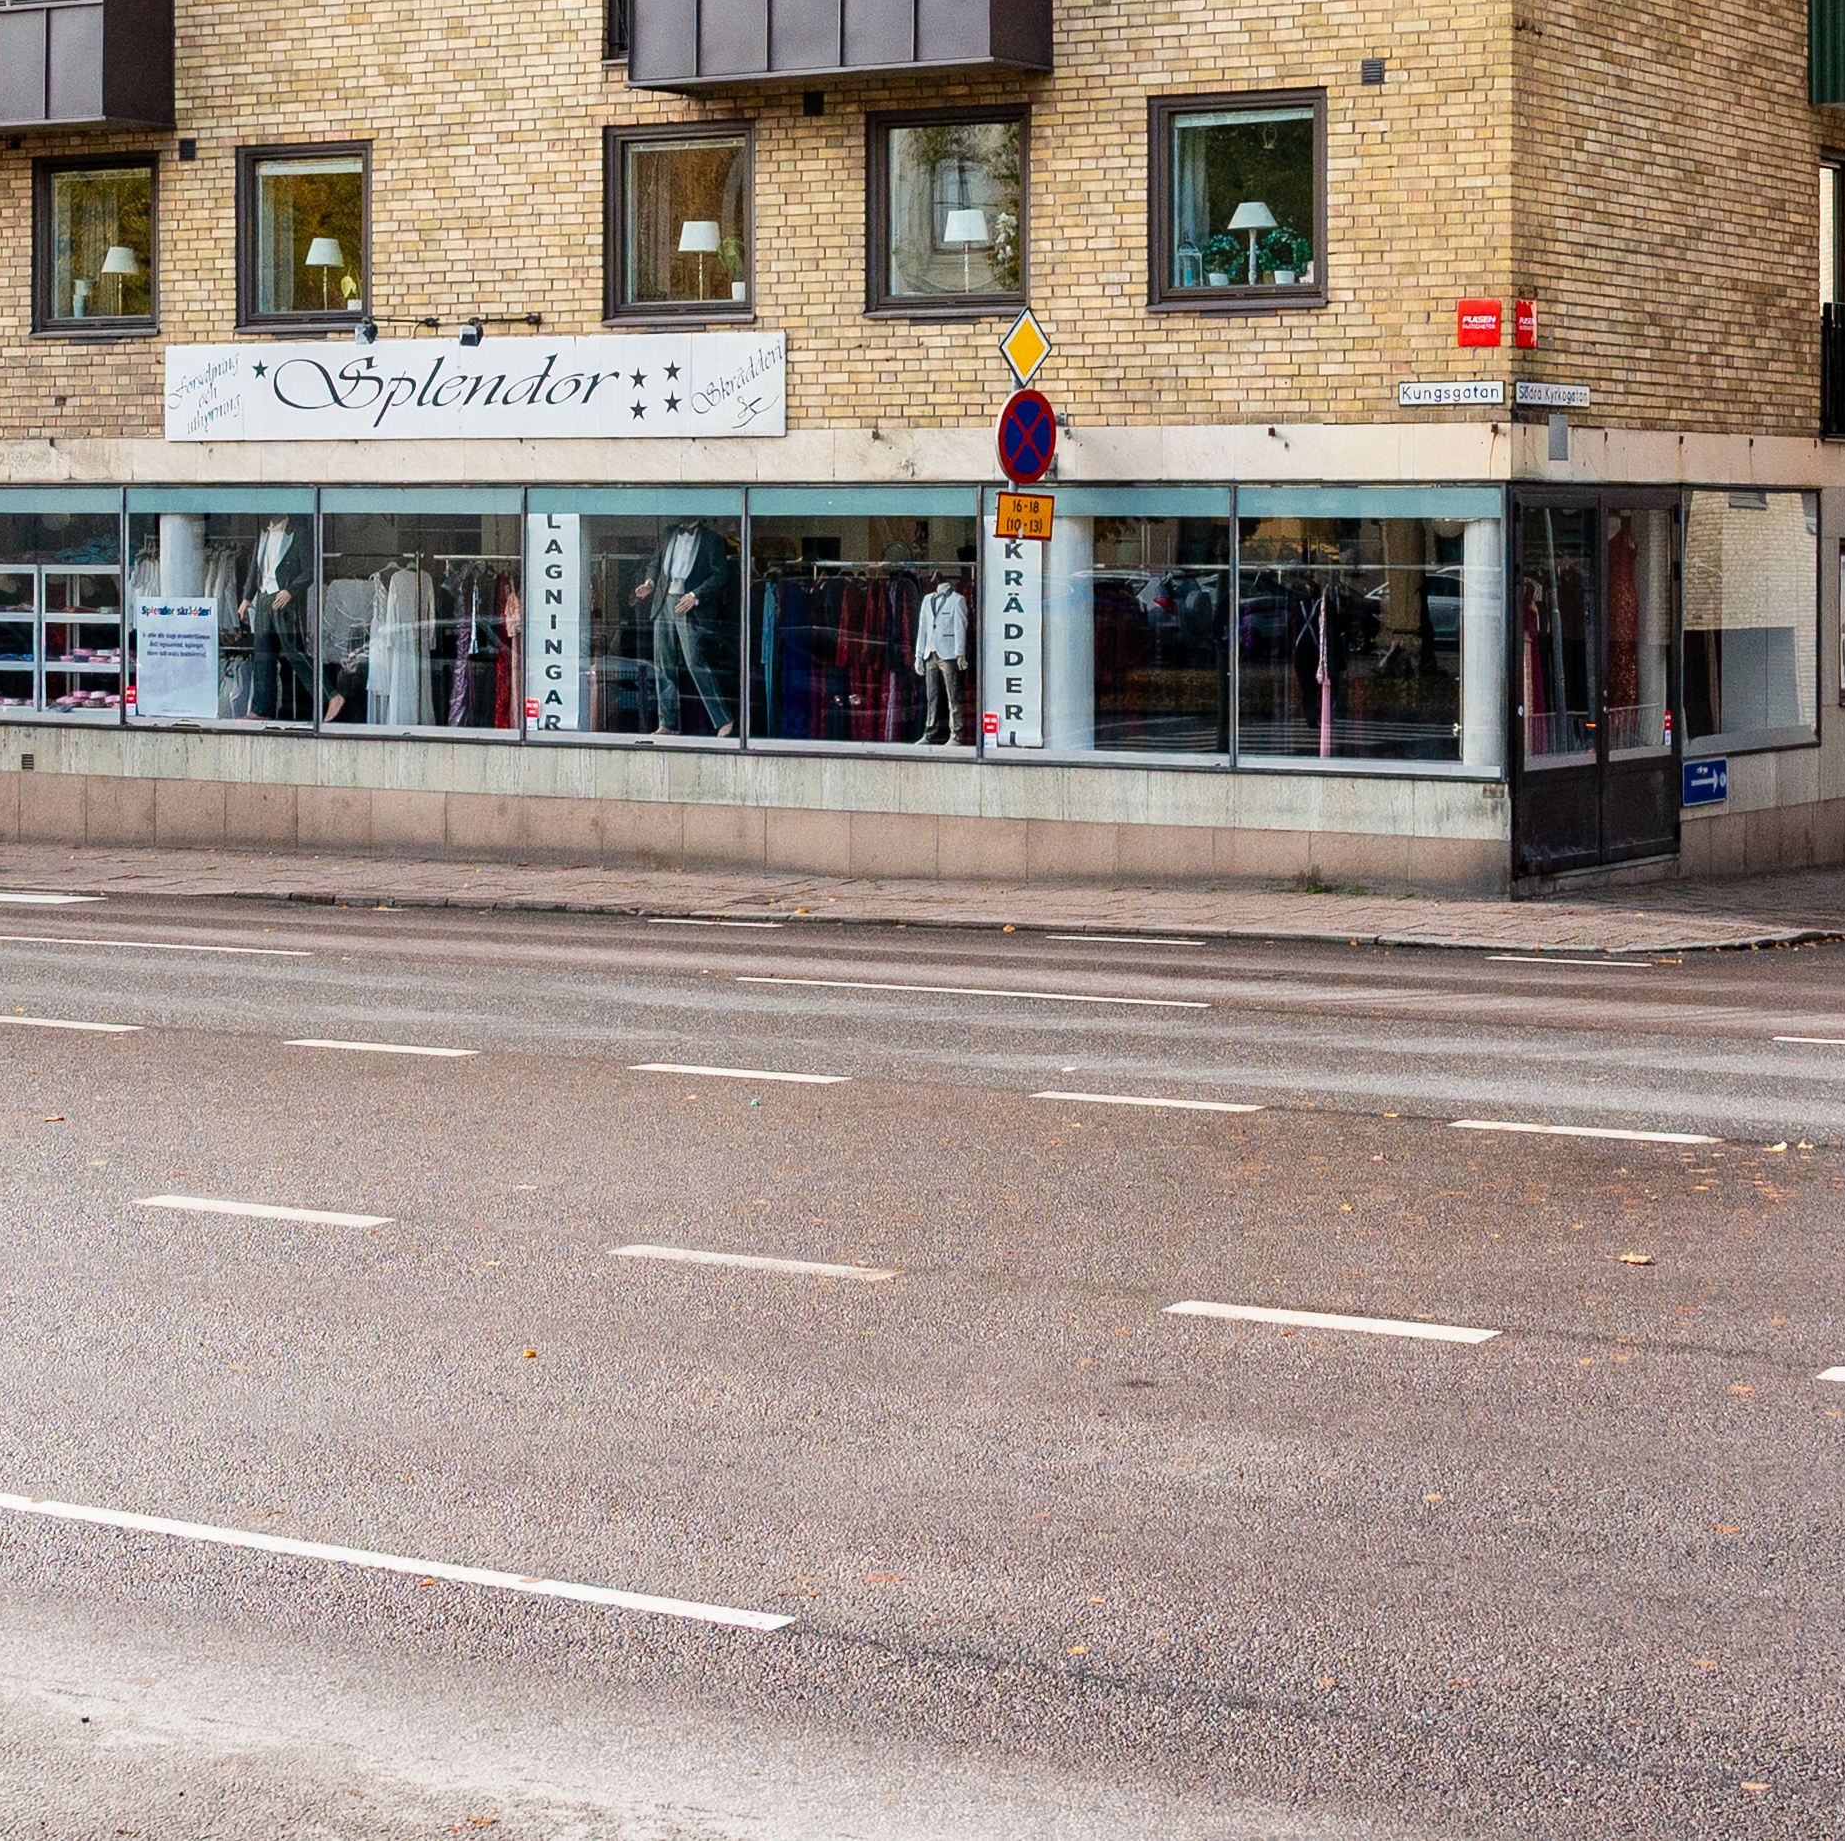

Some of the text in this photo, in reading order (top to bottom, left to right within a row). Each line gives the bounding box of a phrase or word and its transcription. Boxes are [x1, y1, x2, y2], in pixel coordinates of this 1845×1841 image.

[1461, 315, 1497, 324] PULSEN
[273, 353, 620, 428] Splendor
[691, 339, 783, 414] Skrädderi
[1401, 385, 1499, 402] Kungsgatan
[1518, 385, 1588, 405] Södra Kyrkogatan
[141, 605, 175, 617] Splendor
[544, 514, 564, 731] LAGNINGAR
[1003, 542, 1024, 745] KRÄDDERI
